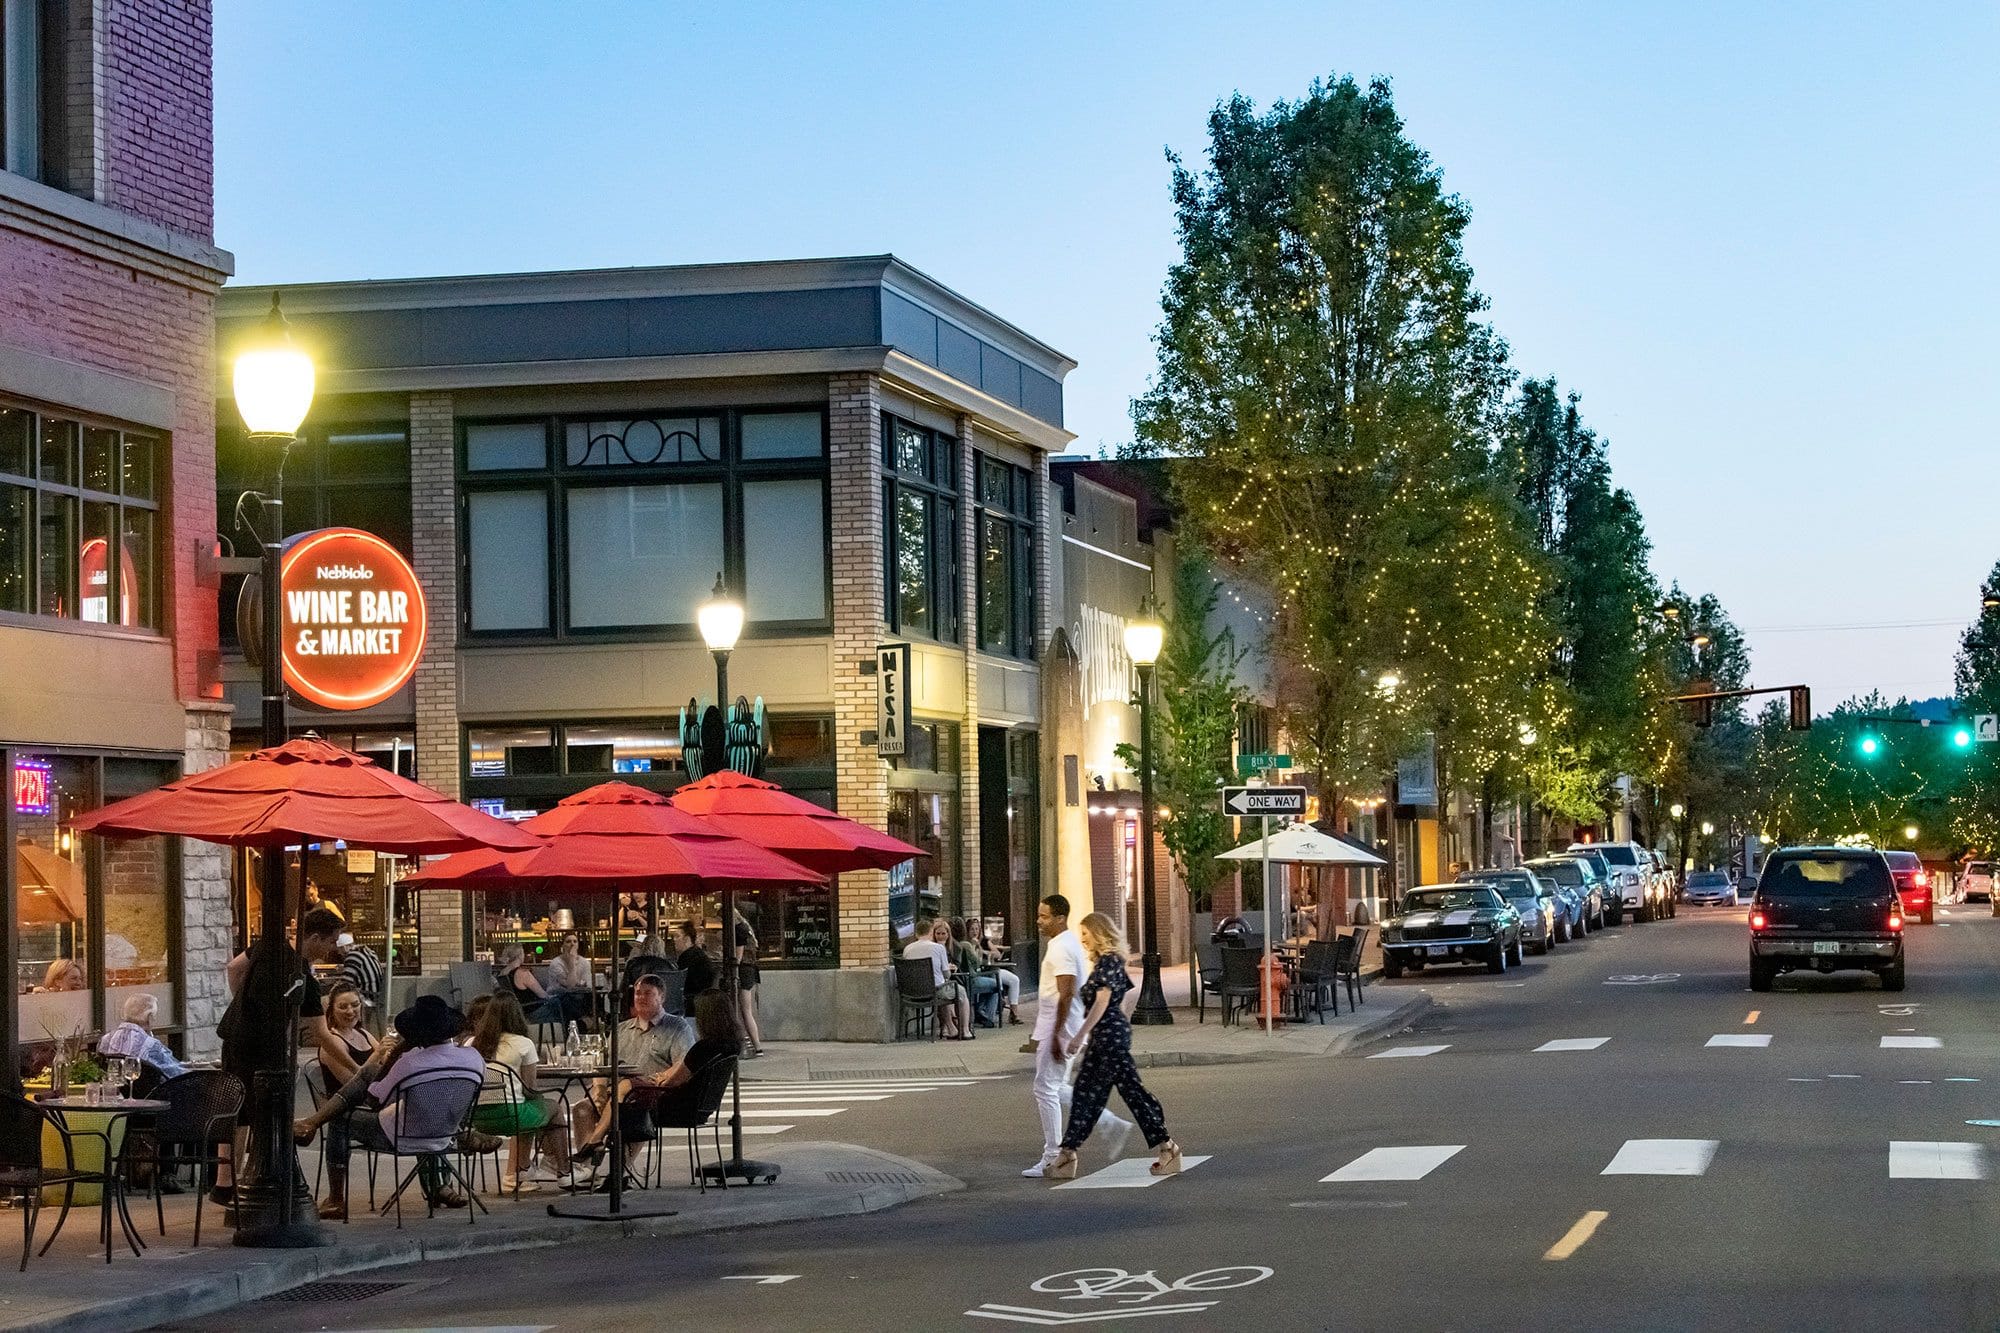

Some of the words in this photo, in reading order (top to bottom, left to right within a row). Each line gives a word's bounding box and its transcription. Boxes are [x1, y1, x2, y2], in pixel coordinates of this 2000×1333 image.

[316, 564, 374, 579] Nebbiolo
[287, 590, 353, 624] WINE
[360, 590, 409, 623] BAR
[321, 629, 402, 655] MARKET
[882, 651, 897, 738] MESA
[880, 741, 903, 752] FRESCA
[1251, 756, 1265, 768] 8th
[1269, 756, 1278, 768] St
[15, 769, 47, 806] PEN
[1248, 796, 1271, 807] ONE
[1274, 796, 1297, 807] WAY
